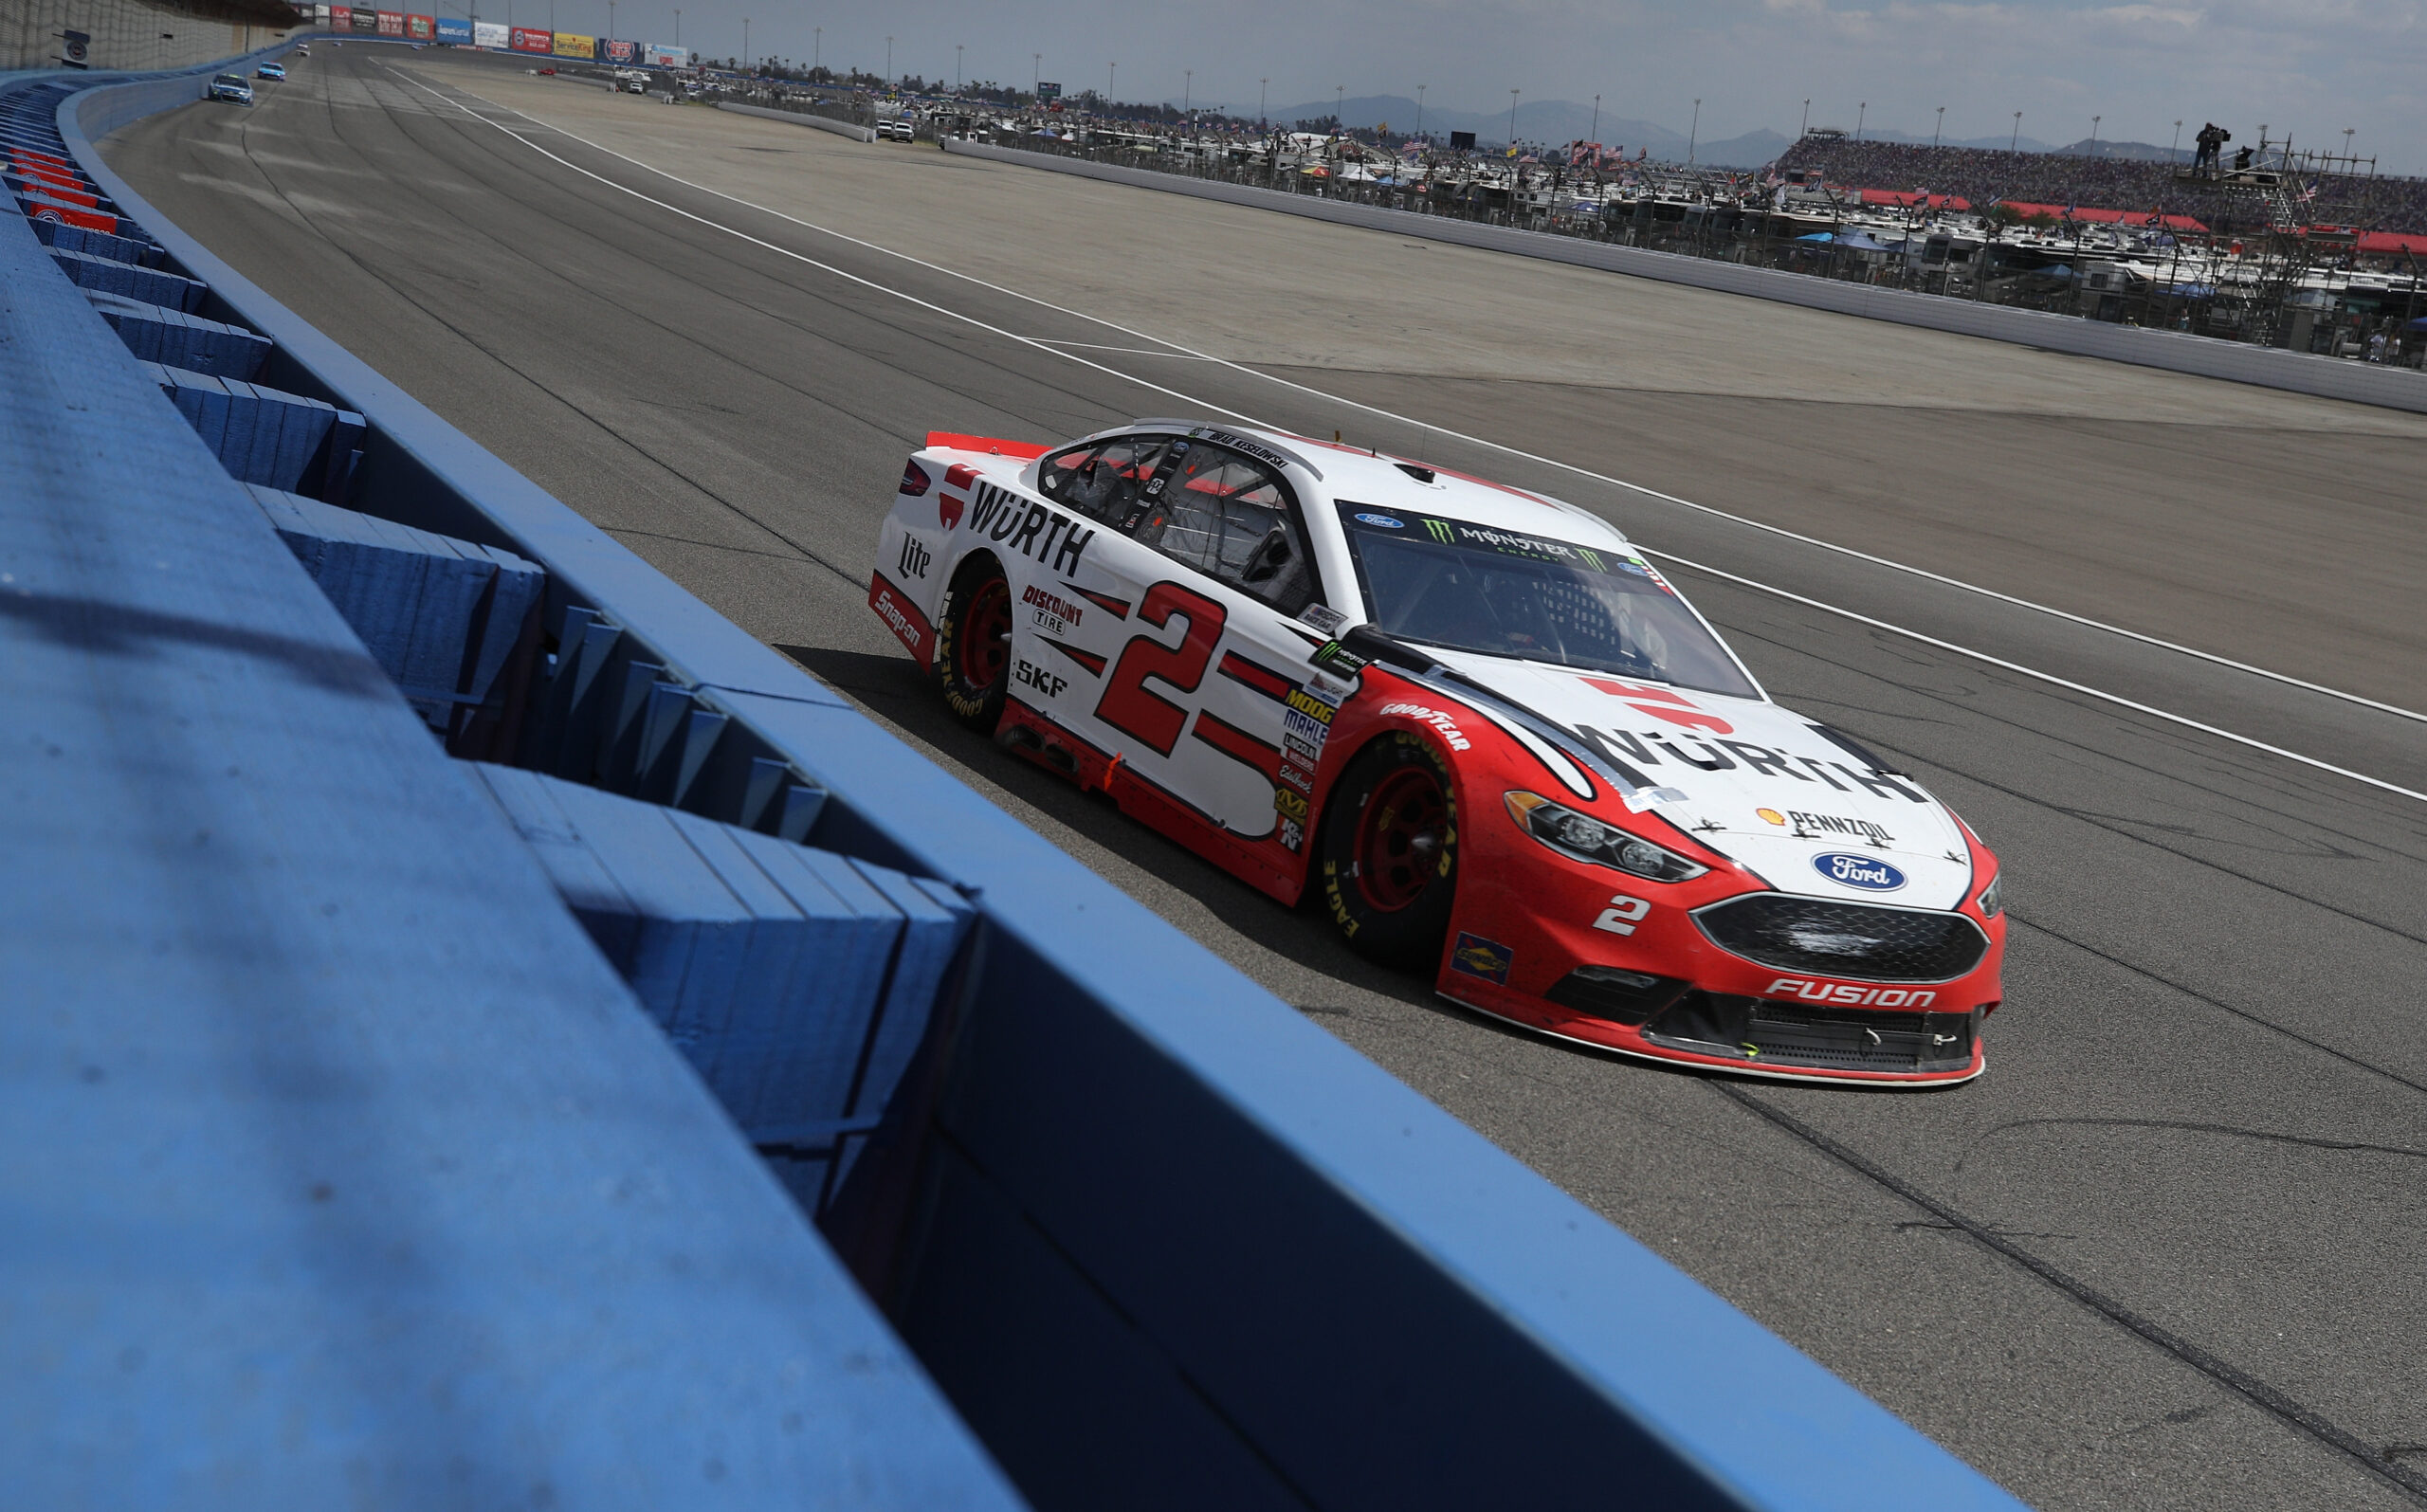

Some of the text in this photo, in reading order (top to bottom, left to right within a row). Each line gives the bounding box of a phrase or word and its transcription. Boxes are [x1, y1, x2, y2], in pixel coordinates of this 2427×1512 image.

[1208, 432, 1289, 469] BRAD KESELOWSKI
[969, 481, 1096, 578] WÜRTH
[1460, 527, 1578, 560] MONSTER
[897, 531, 932, 579] Lite
[874, 590, 922, 647] Snap-on
[1022, 584, 1083, 627] DISCOUNT
[1037, 611, 1064, 632] TIRE
[1015, 659, 1068, 699] SKF
[1093, 579, 1228, 758] 2
[1285, 689, 1336, 724] MOOG
[1284, 708, 1328, 746] MAHLE
[1379, 702, 1471, 752] GOODYEAR
[1286, 735, 1316, 759] LINCOLN
[1787, 810, 1895, 841] PENNZOIL
[1832, 855, 1890, 885] Ford
[1324, 860, 1360, 938] EAGLE
[1592, 895, 1651, 936] 2
[1765, 977, 1937, 1008] FUSION
